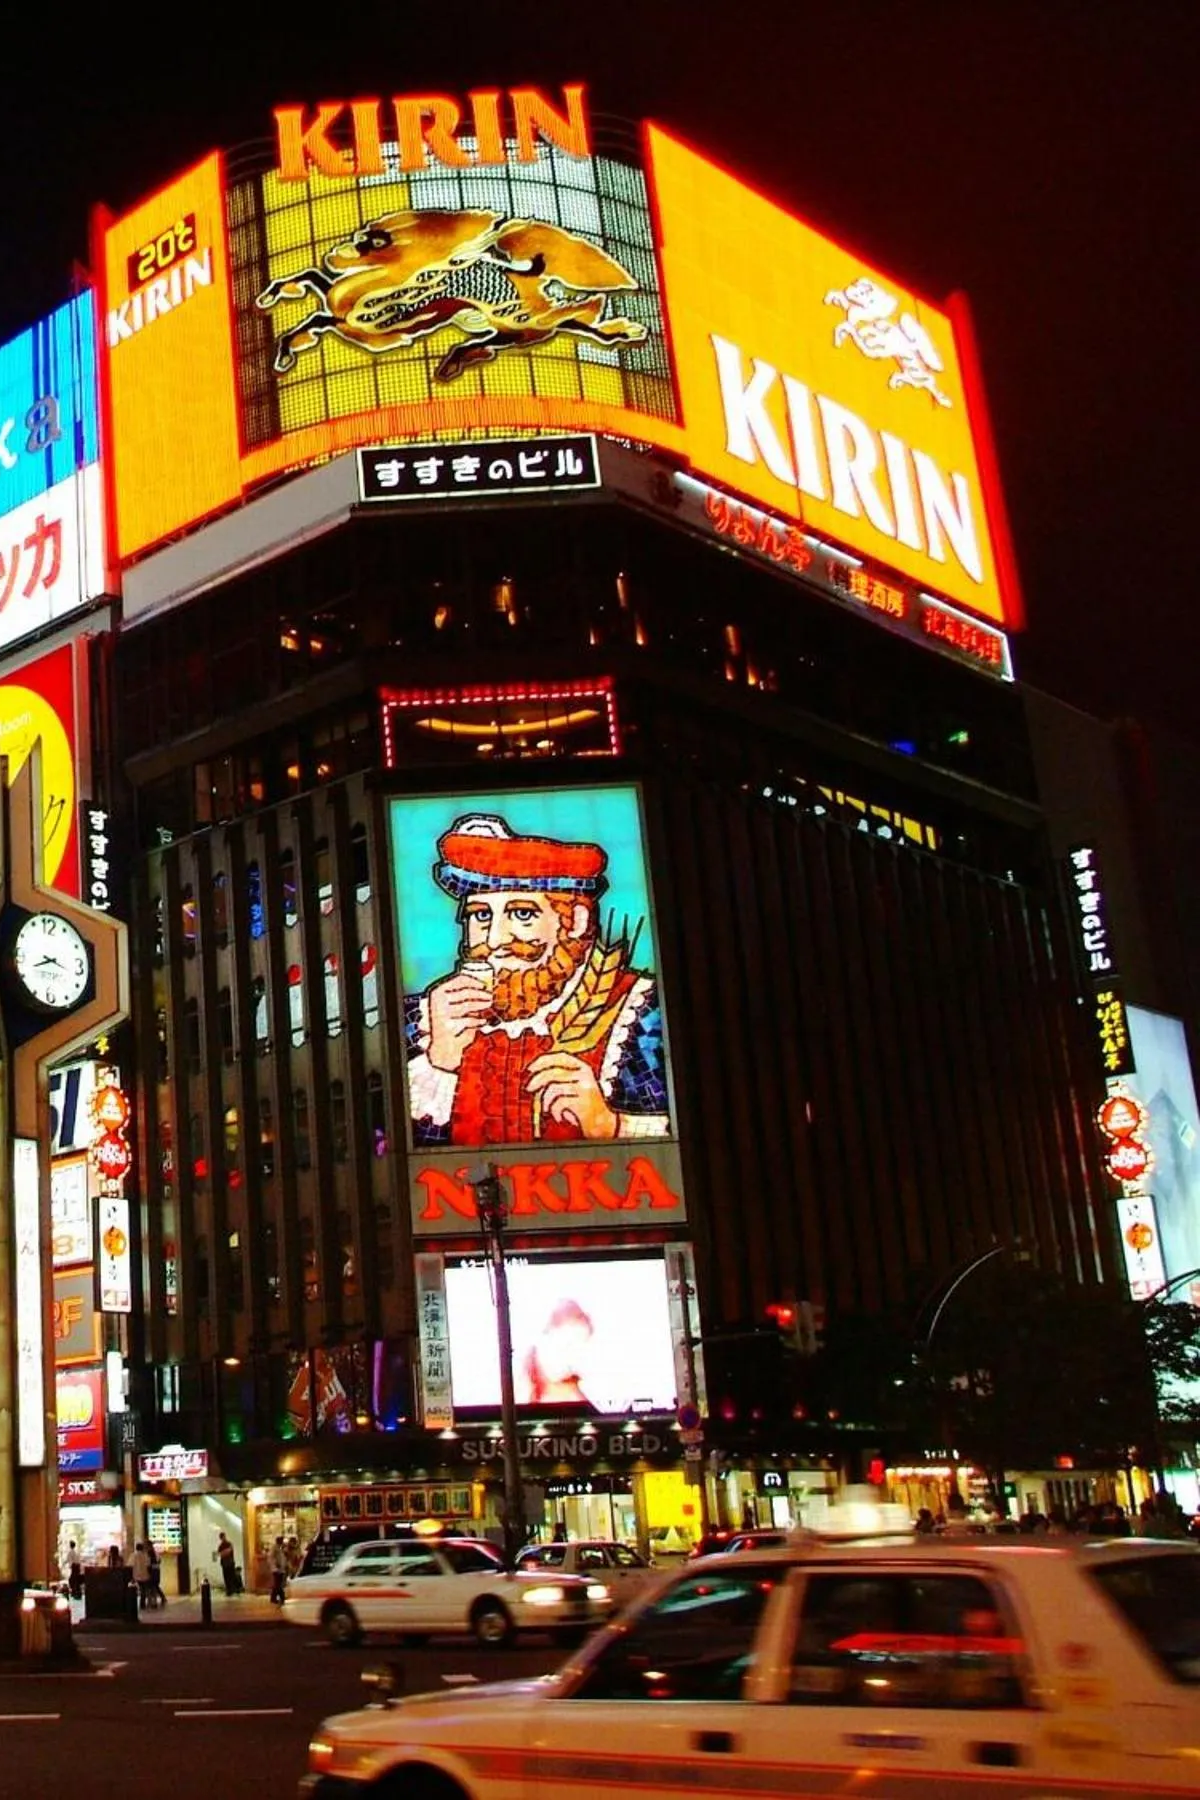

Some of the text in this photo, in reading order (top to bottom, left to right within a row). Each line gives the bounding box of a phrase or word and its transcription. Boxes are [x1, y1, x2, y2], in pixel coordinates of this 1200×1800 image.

[273, 84, 589, 182] KIRIN
[106, 247, 214, 347] KIRIN
[374, 446, 584, 488] すすきのビル
[710, 333, 984, 585] KIRIN
[42, 918, 57, 937] 12
[1069, 846, 1112, 972] すすきのビル
[75, 958, 84, 976] 3
[608, 1434, 668, 1456] BLD.
